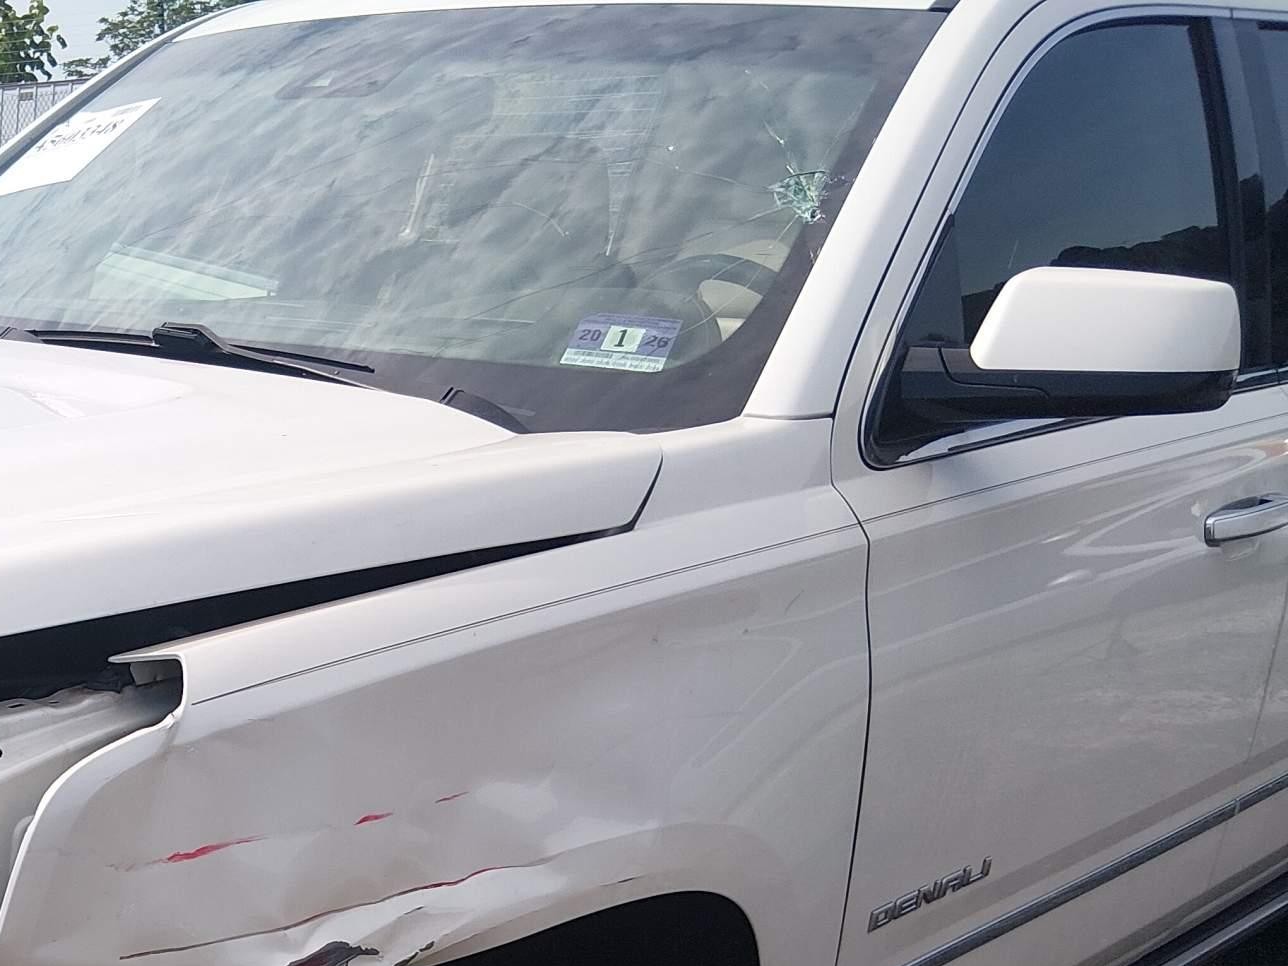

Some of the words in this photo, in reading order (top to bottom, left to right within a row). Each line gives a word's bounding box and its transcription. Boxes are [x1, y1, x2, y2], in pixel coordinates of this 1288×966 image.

[578, 329, 602, 342] 20
[614, 328, 628, 347] 1
[867, 856, 992, 933] DENALI
